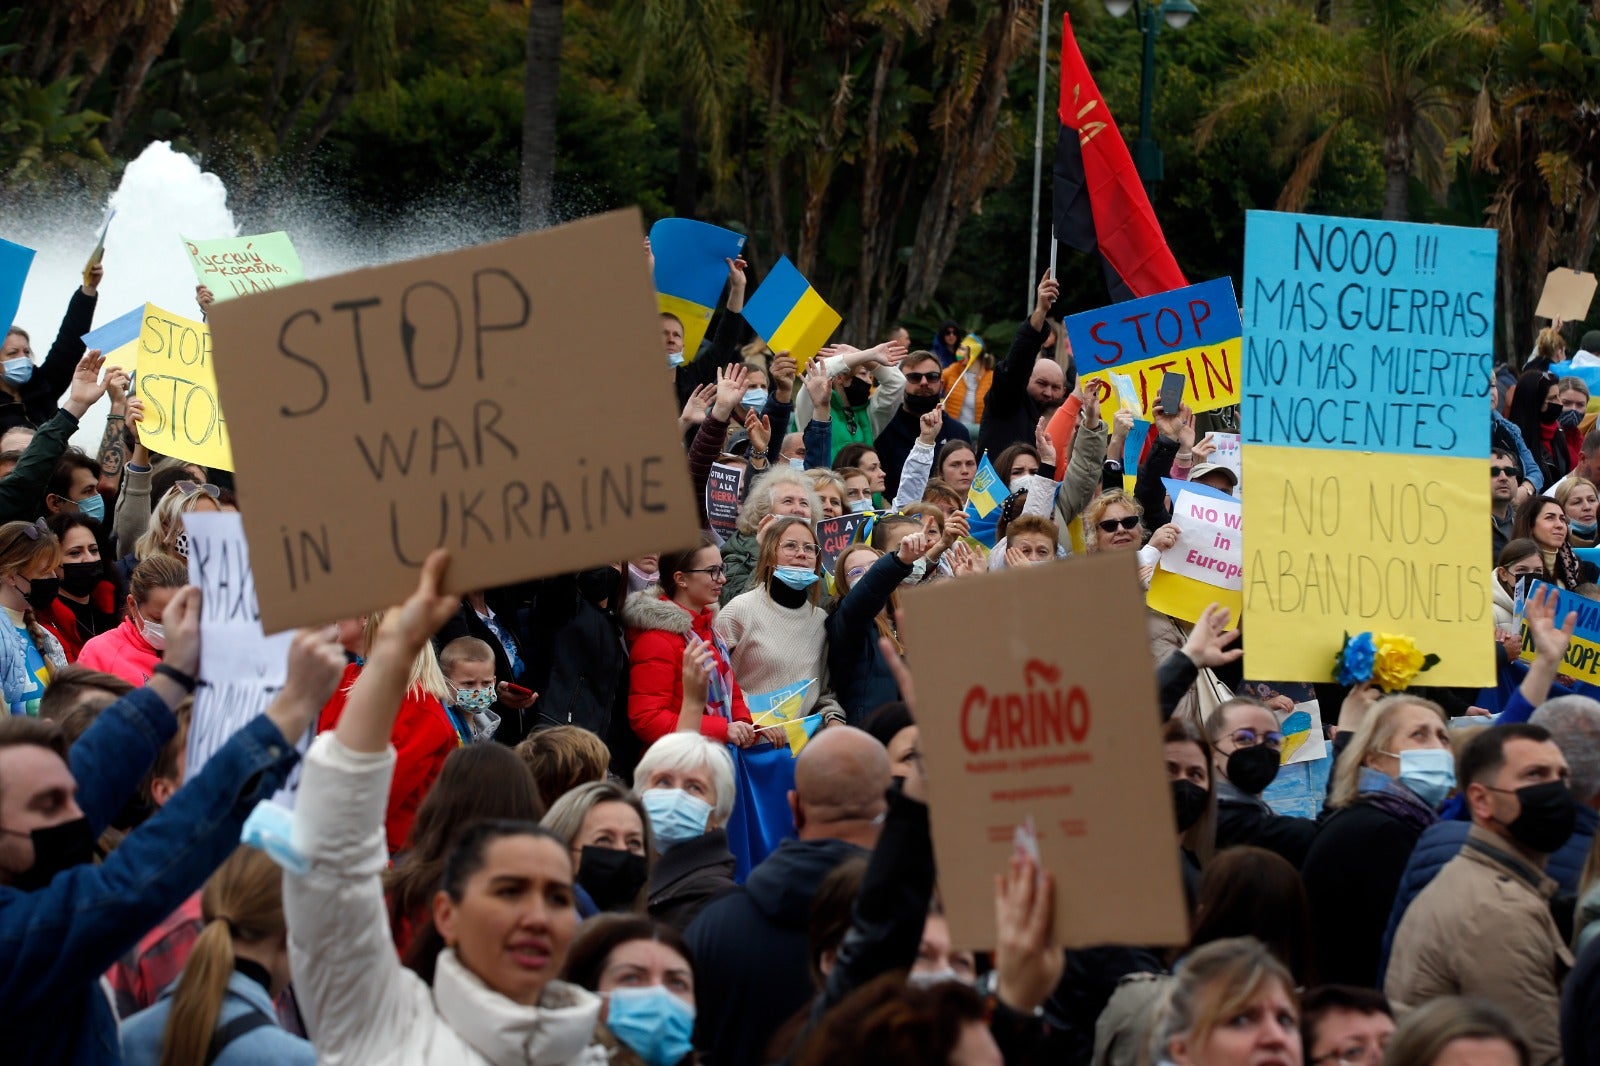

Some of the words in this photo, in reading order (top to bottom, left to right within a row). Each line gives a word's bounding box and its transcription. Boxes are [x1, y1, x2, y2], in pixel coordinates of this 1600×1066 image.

[1294, 222, 1396, 276] NOOO
[1414, 234, 1439, 276] !!!
[1089, 299, 1211, 365] STOP
[1253, 276, 1328, 332] MAS
[1337, 282, 1489, 338] GUERRAS
[278, 268, 532, 418] STOP
[1246, 336, 1288, 387] NO
[1297, 340, 1357, 390] MAS
[1370, 344, 1492, 398] MUERTES
[356, 399, 518, 482] WAR
[1246, 394, 1457, 451] INOCENTES
[710, 470, 724, 480] OTRA
[725, 473, 736, 483] VEZ
[719, 482, 724, 490] A
[725, 483, 733, 491] LA
[823, 520, 839, 535] NO
[844, 520, 854, 531] A
[1191, 504, 1218, 524] NO
[1224, 512, 1242, 531] W
[1282, 475, 1340, 537] NO
[1369, 480, 1448, 545] NOS
[824, 534, 850, 555] GUE
[1213, 532, 1231, 550] in
[1247, 549, 1487, 623] ABANDONEIS
[1568, 599, 1600, 633] WA
[1562, 641, 1600, 674] ROPE
[960, 658, 1092, 754] CARIÑO
